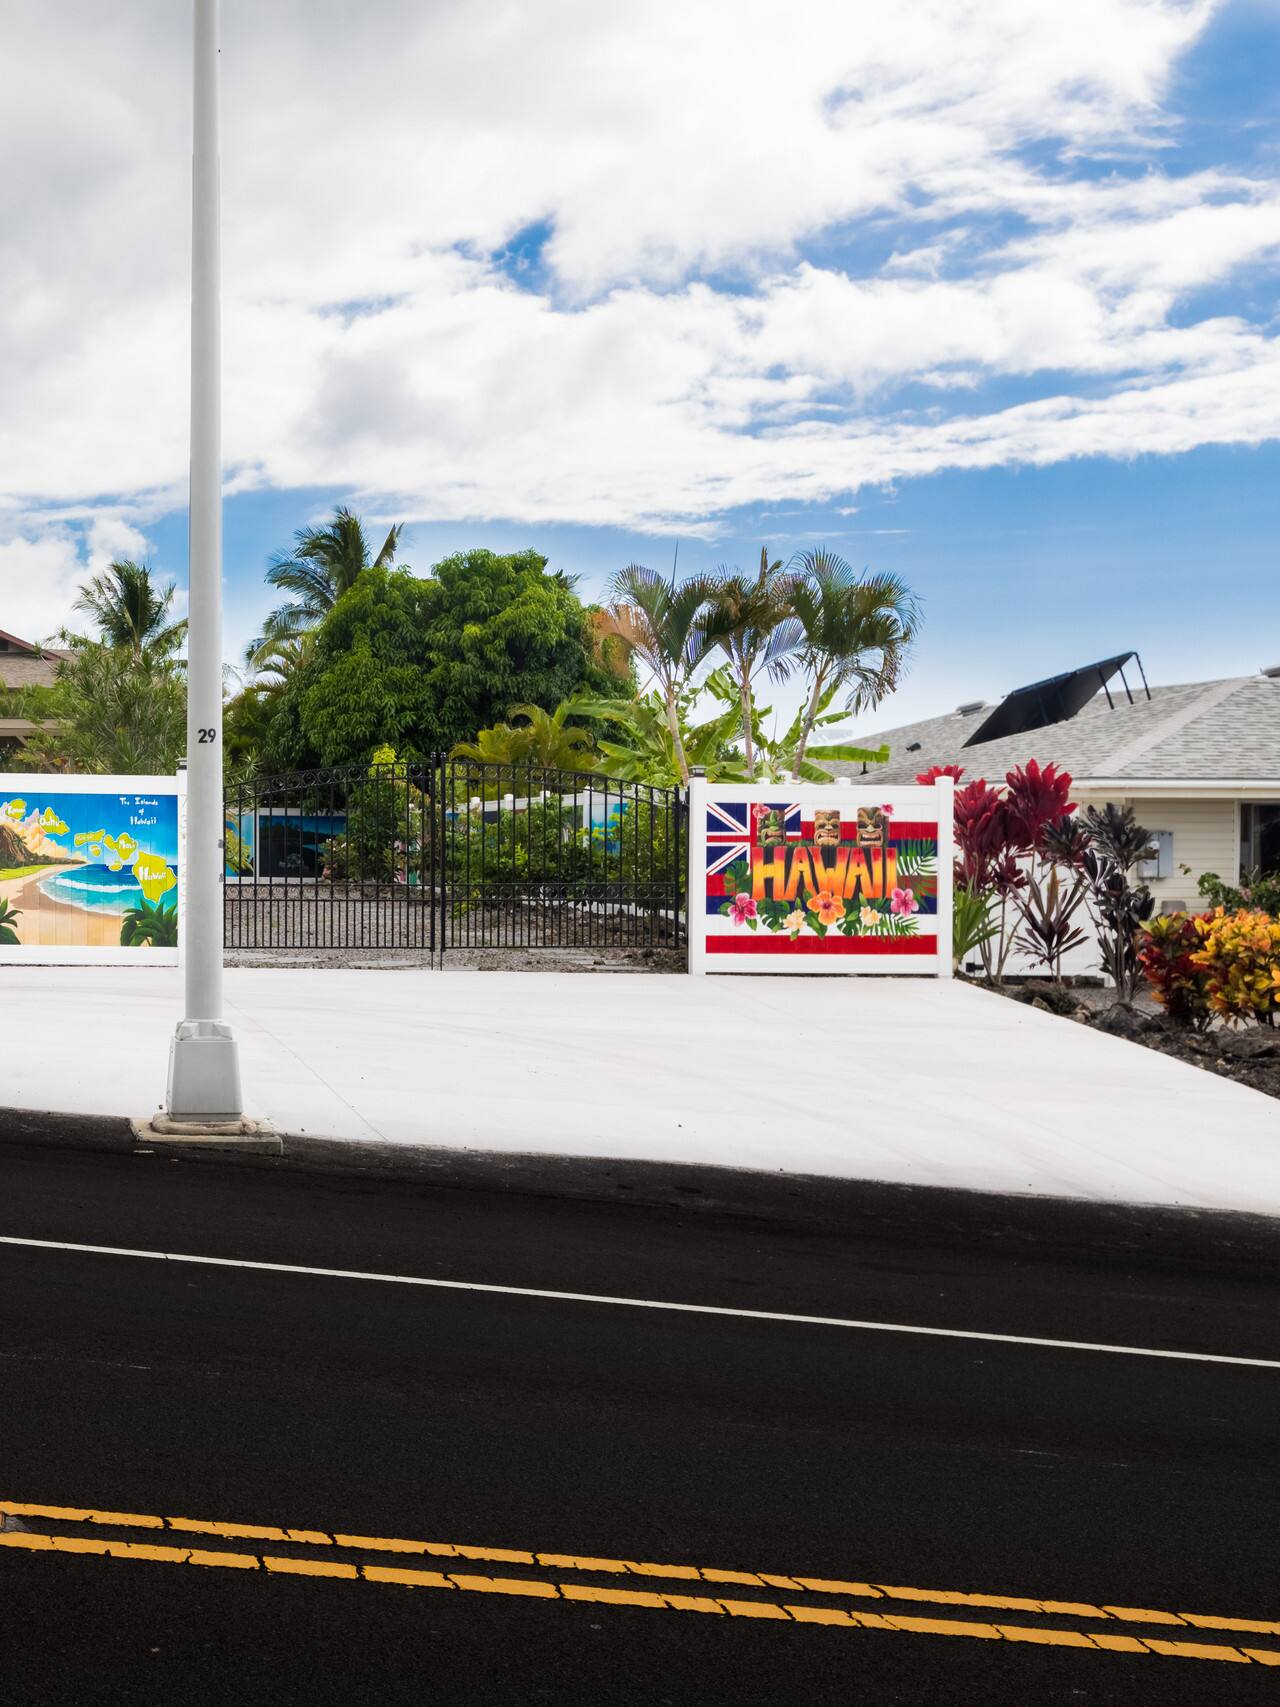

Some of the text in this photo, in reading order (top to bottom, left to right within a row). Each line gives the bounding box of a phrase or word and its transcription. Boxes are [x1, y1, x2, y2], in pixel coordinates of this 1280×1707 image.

[198, 728, 216, 743] 29
[138, 808, 145, 816] of
[130, 816, 157, 825] Hawaii
[751, 846, 897, 900] HAWAII
